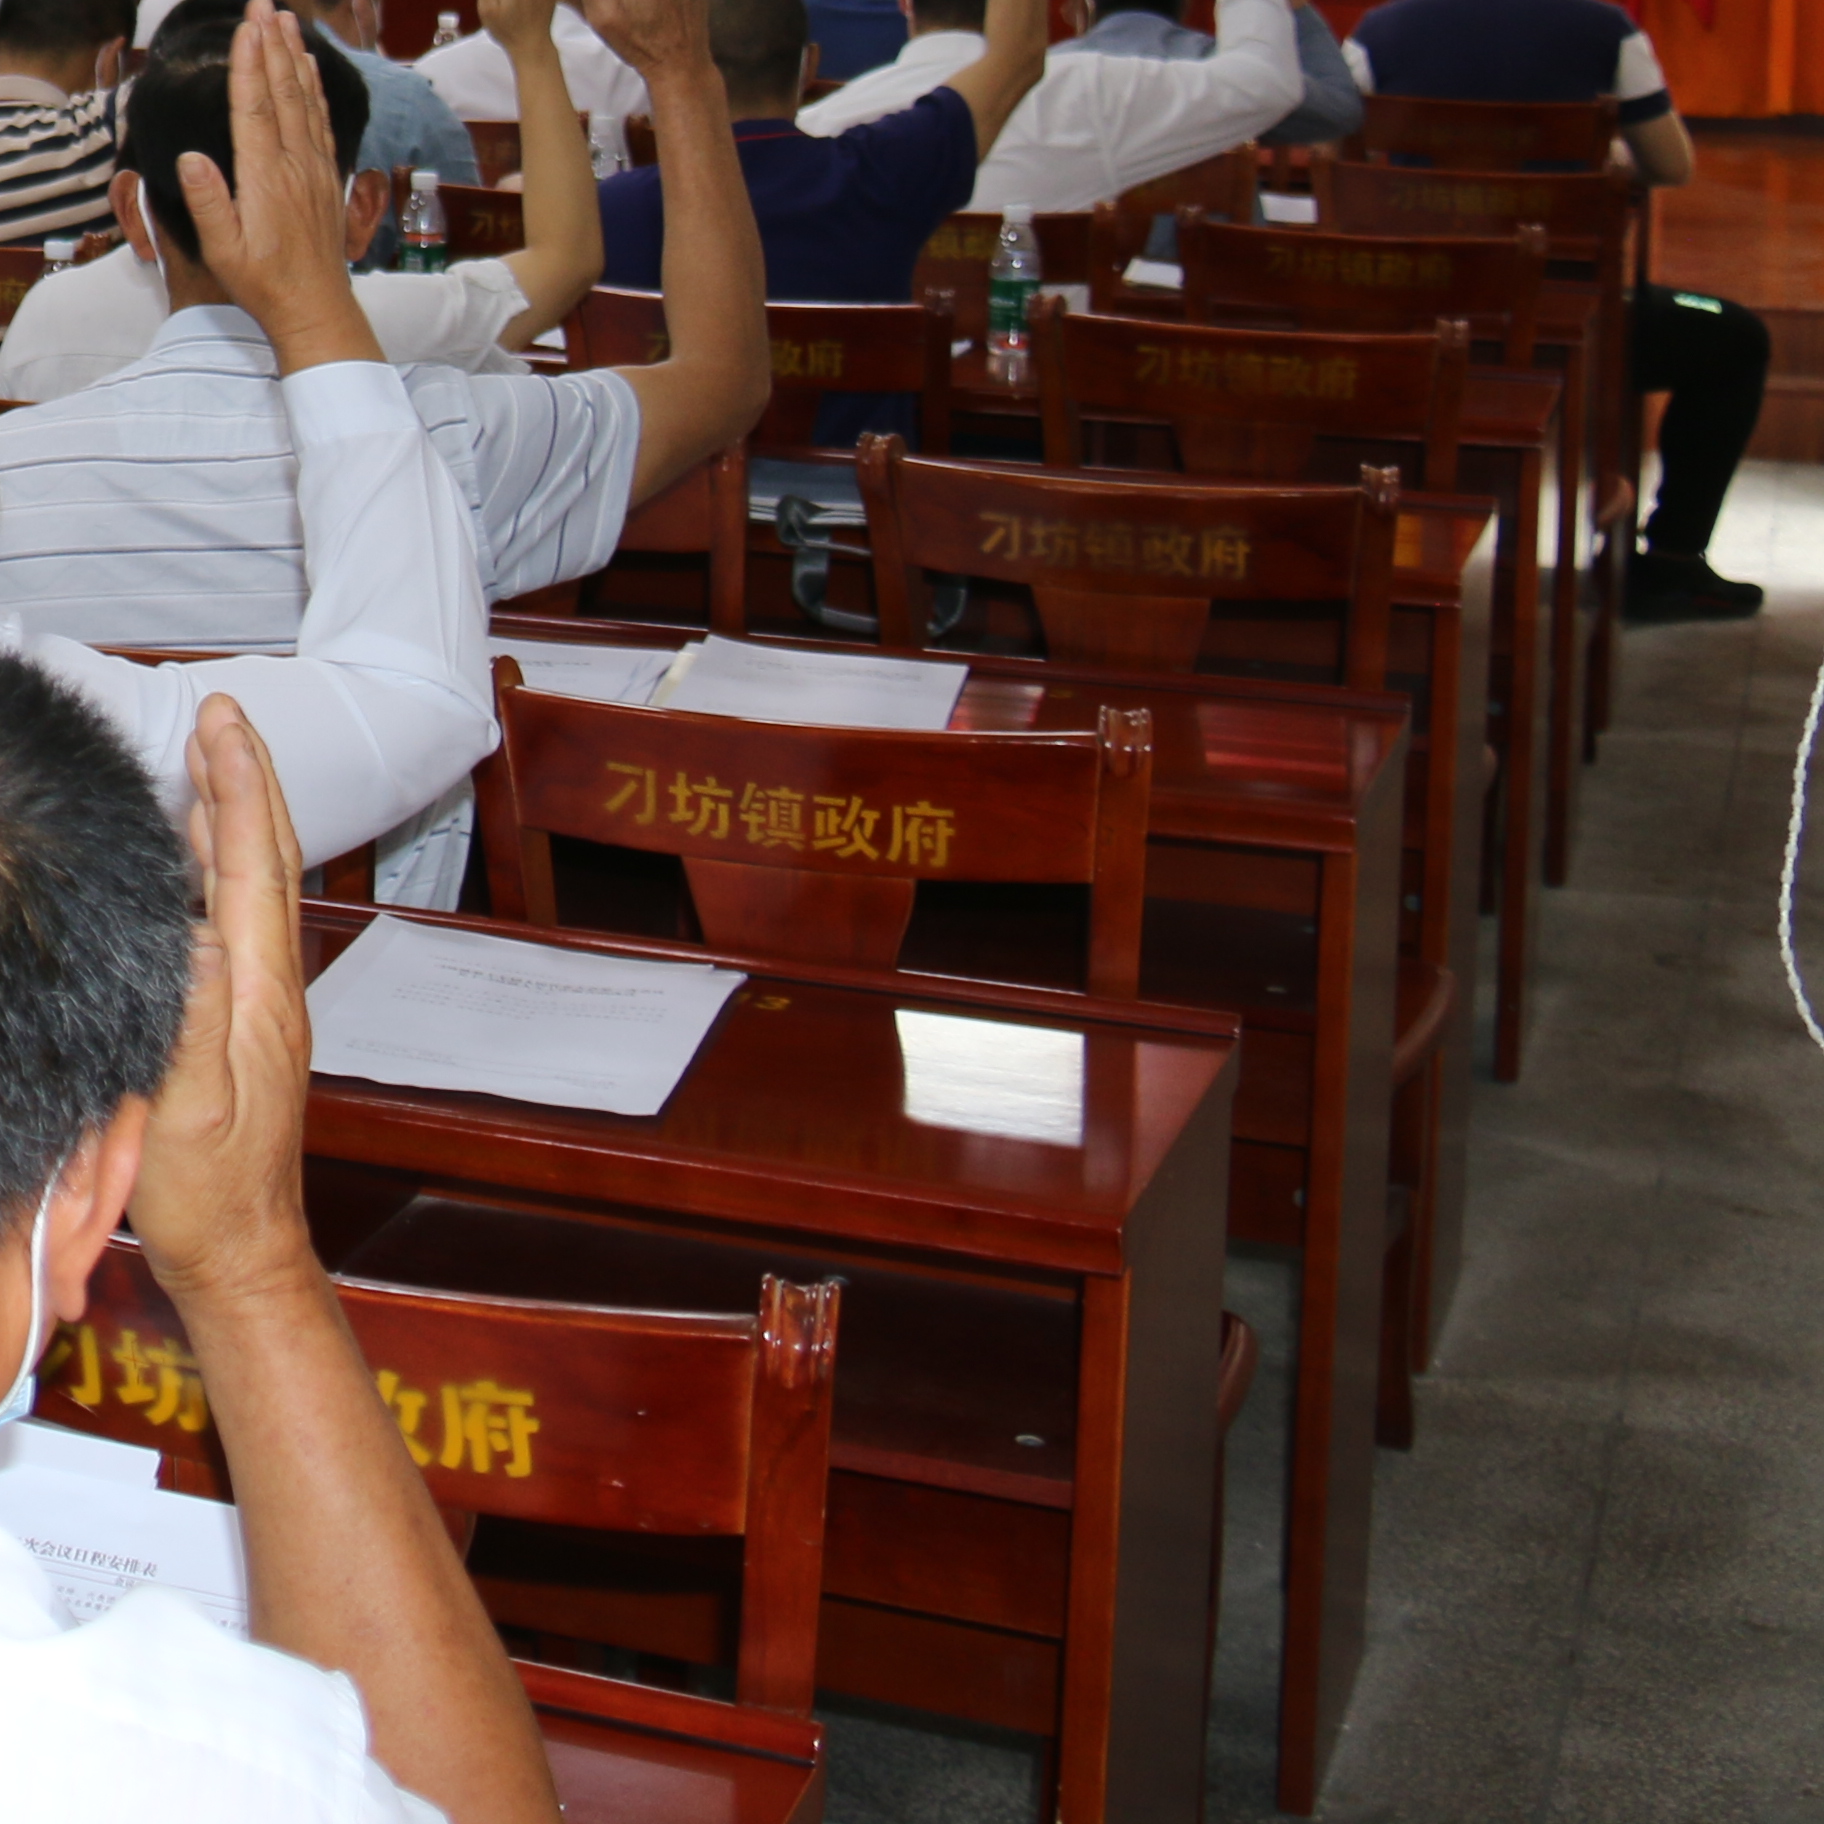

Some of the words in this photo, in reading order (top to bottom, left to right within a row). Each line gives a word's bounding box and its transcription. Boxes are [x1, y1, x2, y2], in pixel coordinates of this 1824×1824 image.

[1137, 344, 1358, 400] 刁坊镇政府
[978, 511, 1251, 578] 刁坊镇政府
[603, 760, 956, 868] 刁坊镇政府
[18, 1535, 159, 1578] 次会议日程安排表
